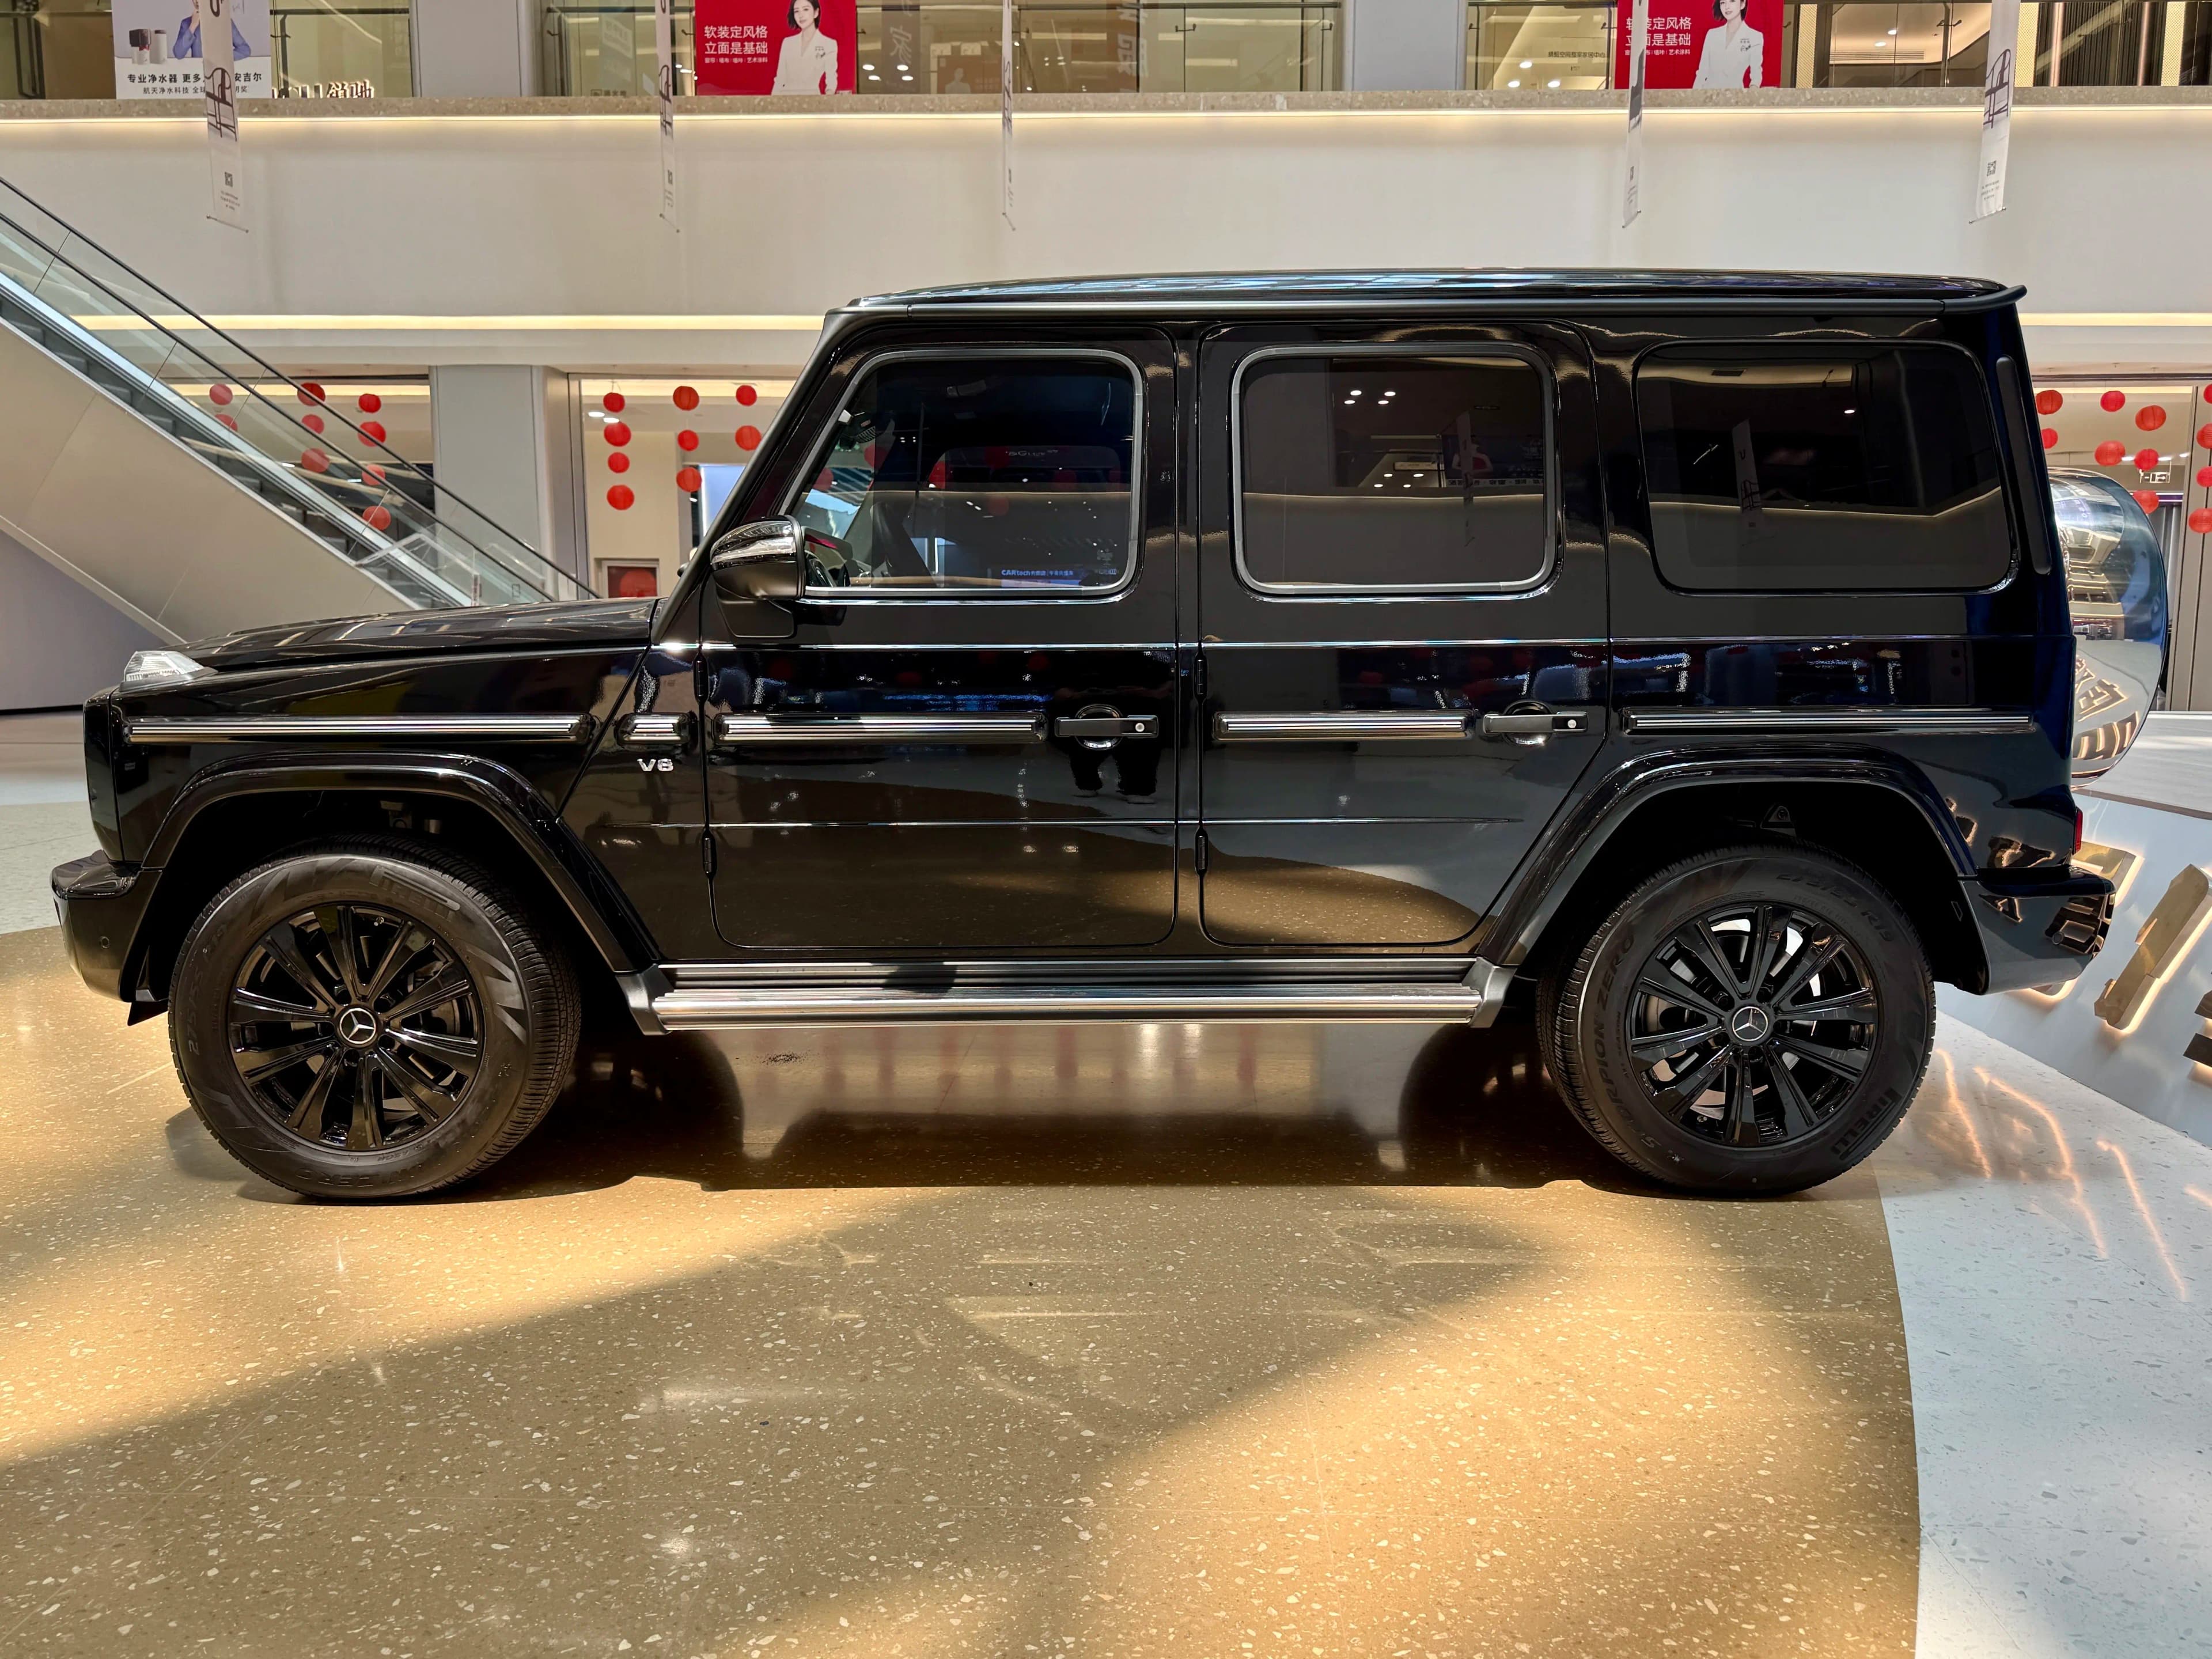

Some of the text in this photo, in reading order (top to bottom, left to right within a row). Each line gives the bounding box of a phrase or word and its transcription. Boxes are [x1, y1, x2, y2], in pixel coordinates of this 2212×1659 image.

[704, 25, 768, 39] 软装定风格
[704, 41, 768, 54] 立面是基础
[127, 73, 177, 84] 专业净水器
[143, 86, 190, 94] 航天净水科技
[637, 758, 673, 771] V8
[1596, 934, 1634, 1012] ZERO
[1831, 1087, 1903, 1160] PIRELLI
